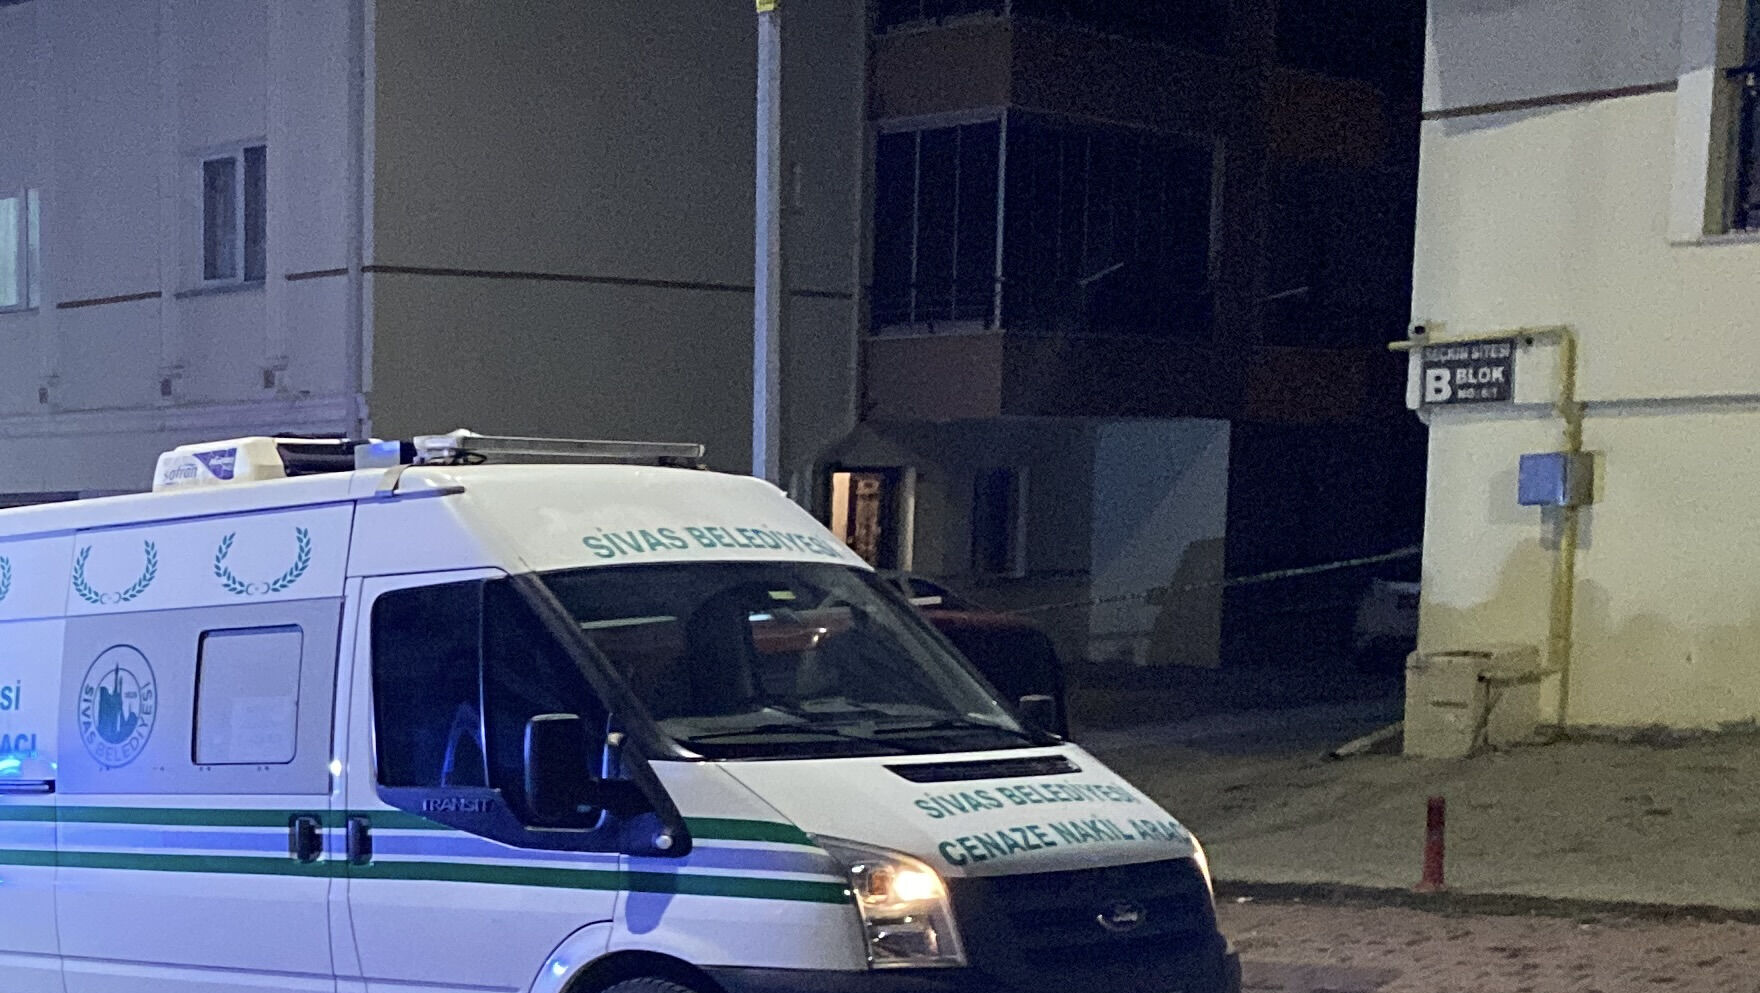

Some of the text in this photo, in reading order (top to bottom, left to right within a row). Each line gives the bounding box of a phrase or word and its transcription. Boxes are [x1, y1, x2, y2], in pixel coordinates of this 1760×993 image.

[1425, 368, 1452, 402] B
[1456, 366, 1505, 384] BLOK
[582, 527, 689, 558] SİVAS
[914, 788, 1004, 820] SİVAS
[938, 824, 1058, 867] CENAZE
[1048, 813, 1135, 845] NAKİL
